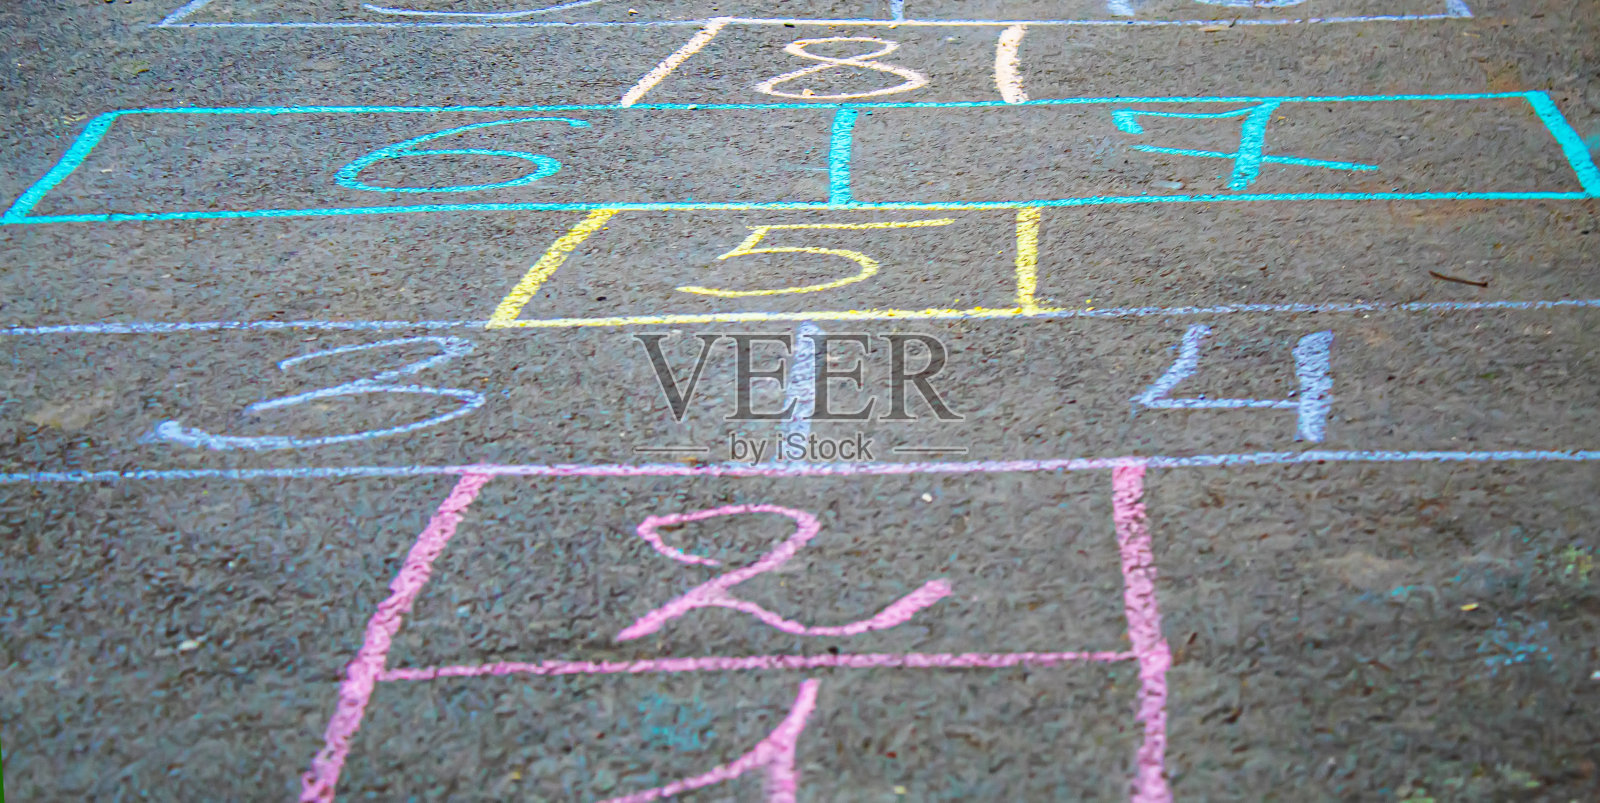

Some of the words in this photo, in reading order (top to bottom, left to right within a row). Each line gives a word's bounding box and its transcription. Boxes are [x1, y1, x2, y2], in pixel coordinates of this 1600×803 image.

[756, 36, 929, 99] 8
[334, 117, 592, 193] 6
[1111, 101, 1379, 191] 7
[676, 218, 955, 298] 5
[138, 336, 486, 450] 3
[1130, 325, 1334, 443] 4
[615, 503, 953, 641] 2
